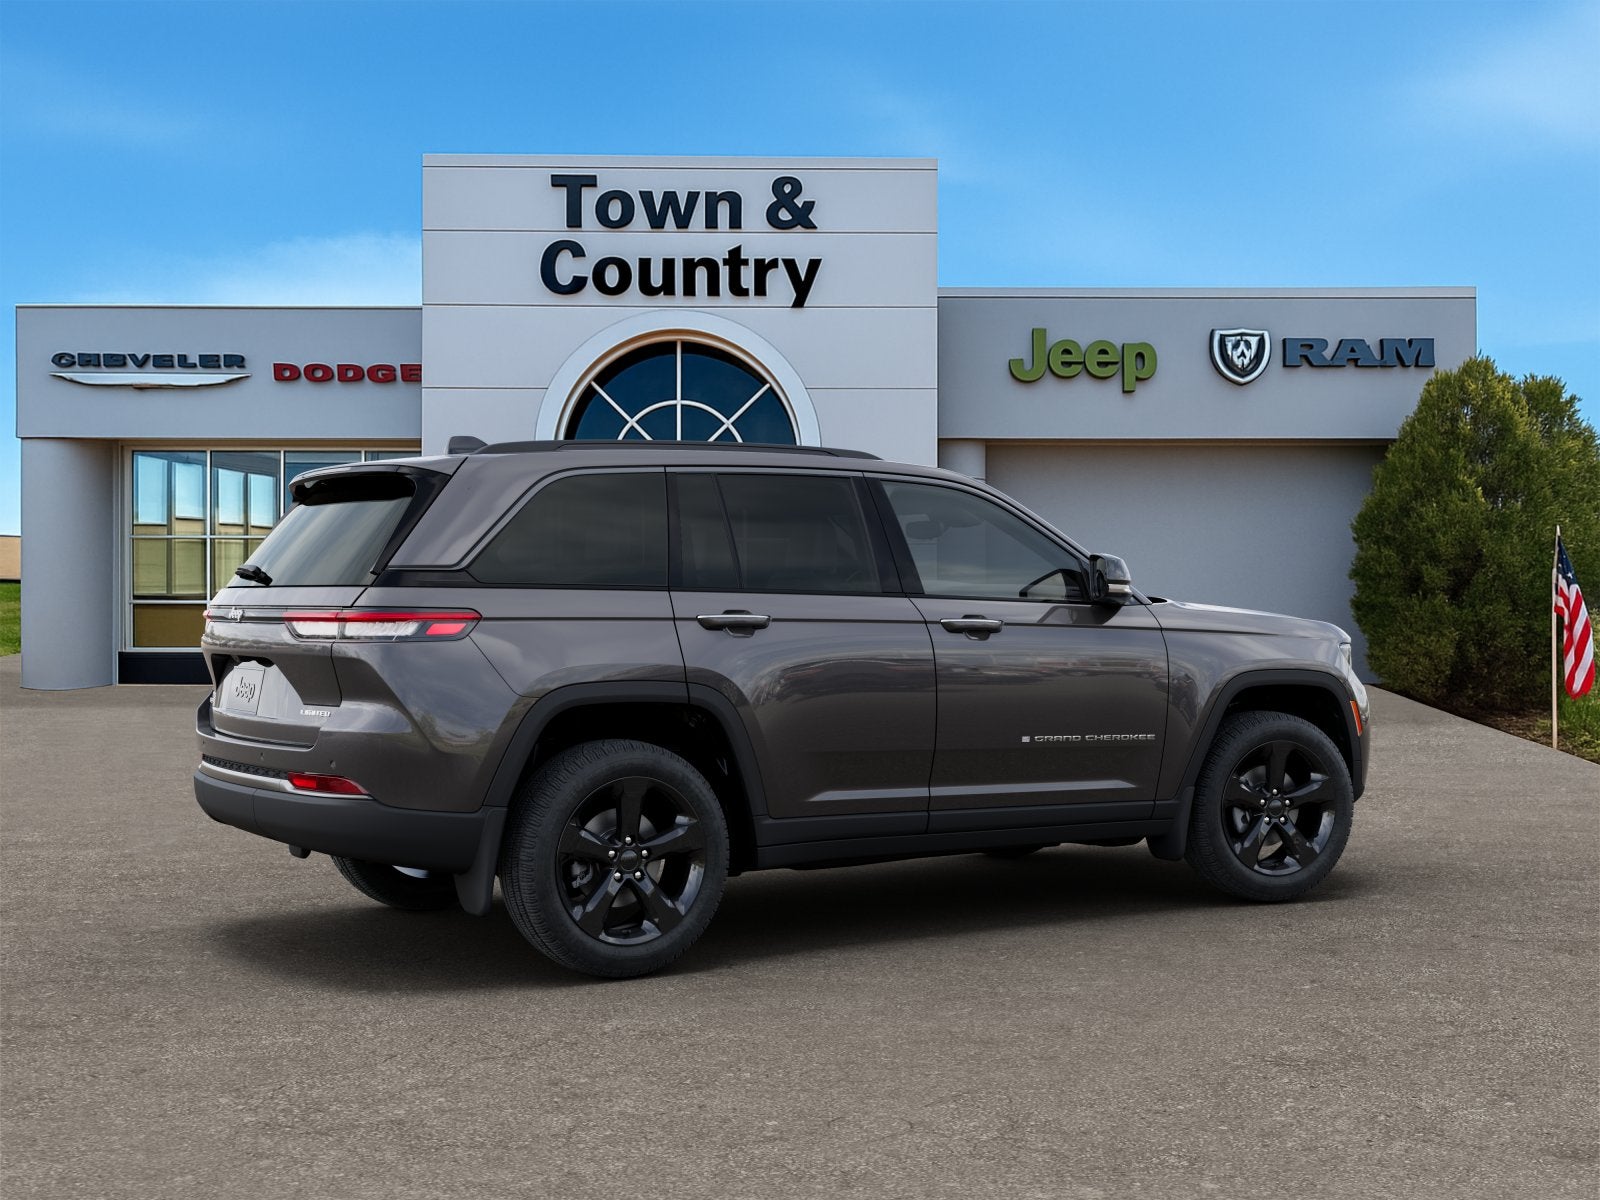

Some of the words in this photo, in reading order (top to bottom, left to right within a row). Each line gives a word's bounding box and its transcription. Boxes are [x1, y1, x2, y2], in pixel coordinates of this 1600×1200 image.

[550, 174, 743, 230] Town
[766, 176, 818, 230] &
[540, 239, 823, 308] Country
[273, 362, 422, 383] DODGE
[1009, 328, 1158, 393] Jeep
[1283, 337, 1436, 368] RAM
